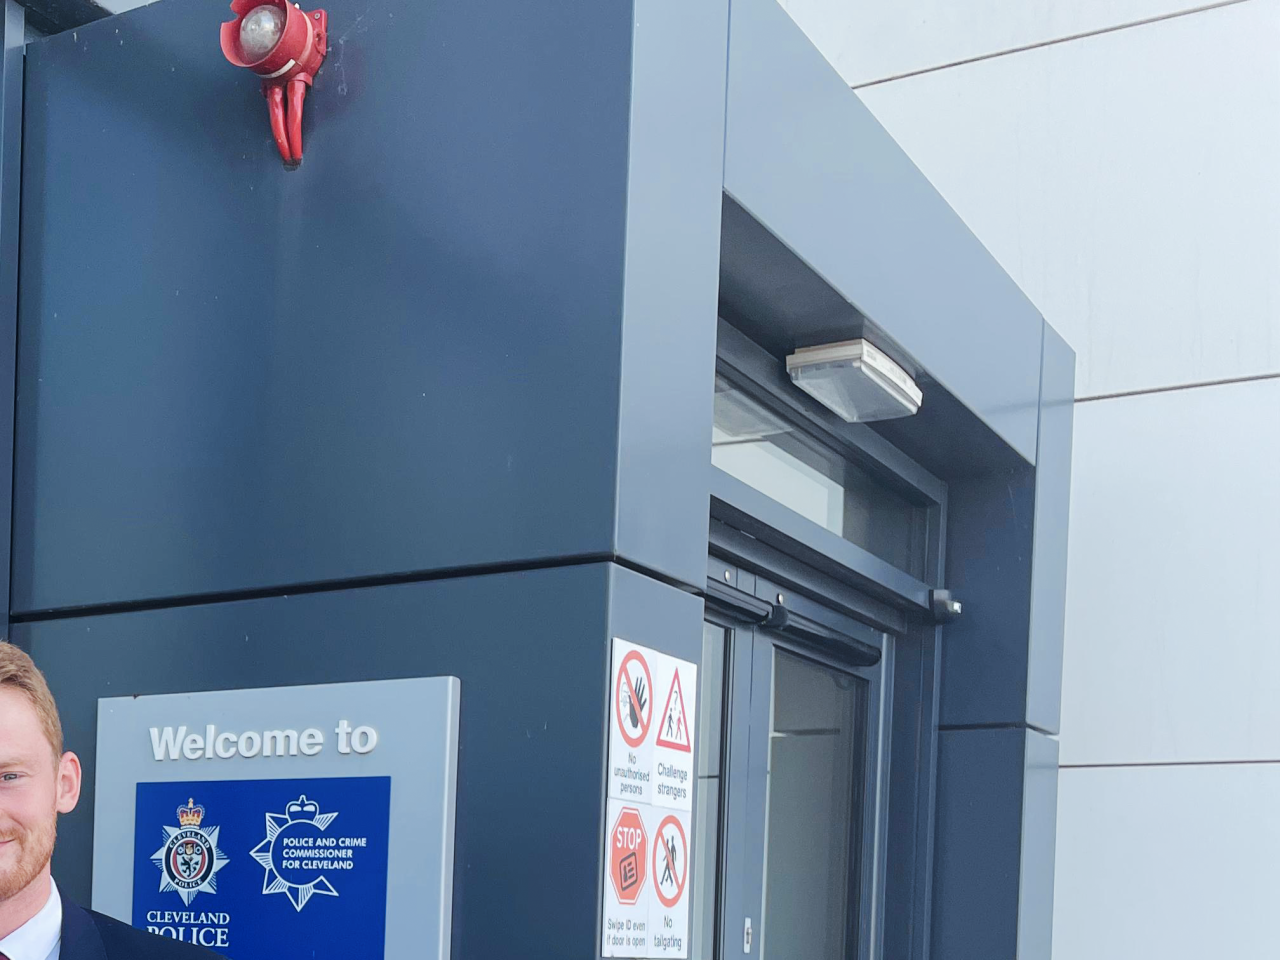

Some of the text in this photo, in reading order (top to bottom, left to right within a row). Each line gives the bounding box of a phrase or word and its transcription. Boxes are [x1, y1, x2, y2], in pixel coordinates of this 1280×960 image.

[149, 720, 377, 761] Welcome to
[628, 752, 636, 764] No
[614, 767, 649, 782] unauthorised
[658, 763, 687, 783] Challenge
[620, 781, 642, 795] persons
[658, 781, 686, 800] strangers
[170, 832, 210, 848] CLEVELAND
[283, 838, 367, 847] POLICE AND CRIME
[617, 827, 642, 850] STOP
[283, 849, 353, 858] COMMISSIONER
[283, 861, 353, 869] FOR CLEVELAND
[174, 878, 202, 888] POLICE
[147, 911, 229, 925] CLEVELAND
[608, 918, 645, 932] Swipe ID even
[664, 915, 672, 928] No
[612, 935, 624, 946] door
[632, 938, 645, 949] open
[654, 935, 681, 950] tailgating
